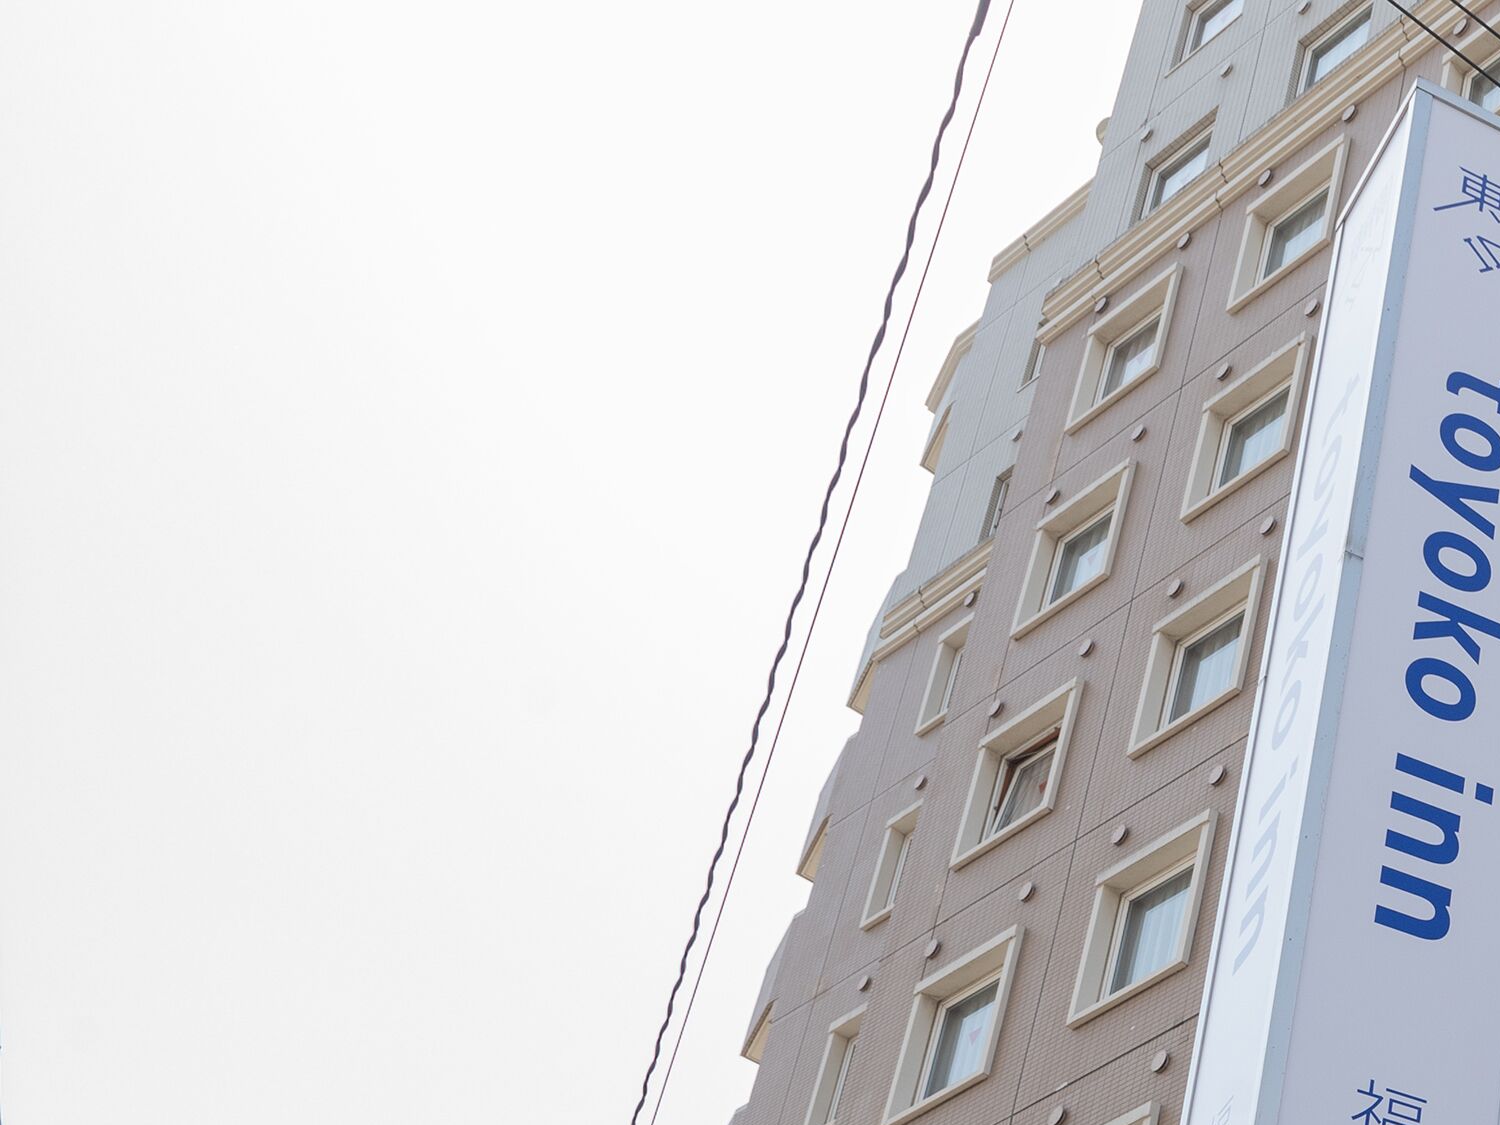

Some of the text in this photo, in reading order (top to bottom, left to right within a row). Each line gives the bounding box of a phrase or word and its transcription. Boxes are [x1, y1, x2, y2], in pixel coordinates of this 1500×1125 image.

[1232, 373, 1360, 976] toyoko inn
[1374, 752, 1494, 943] inn
